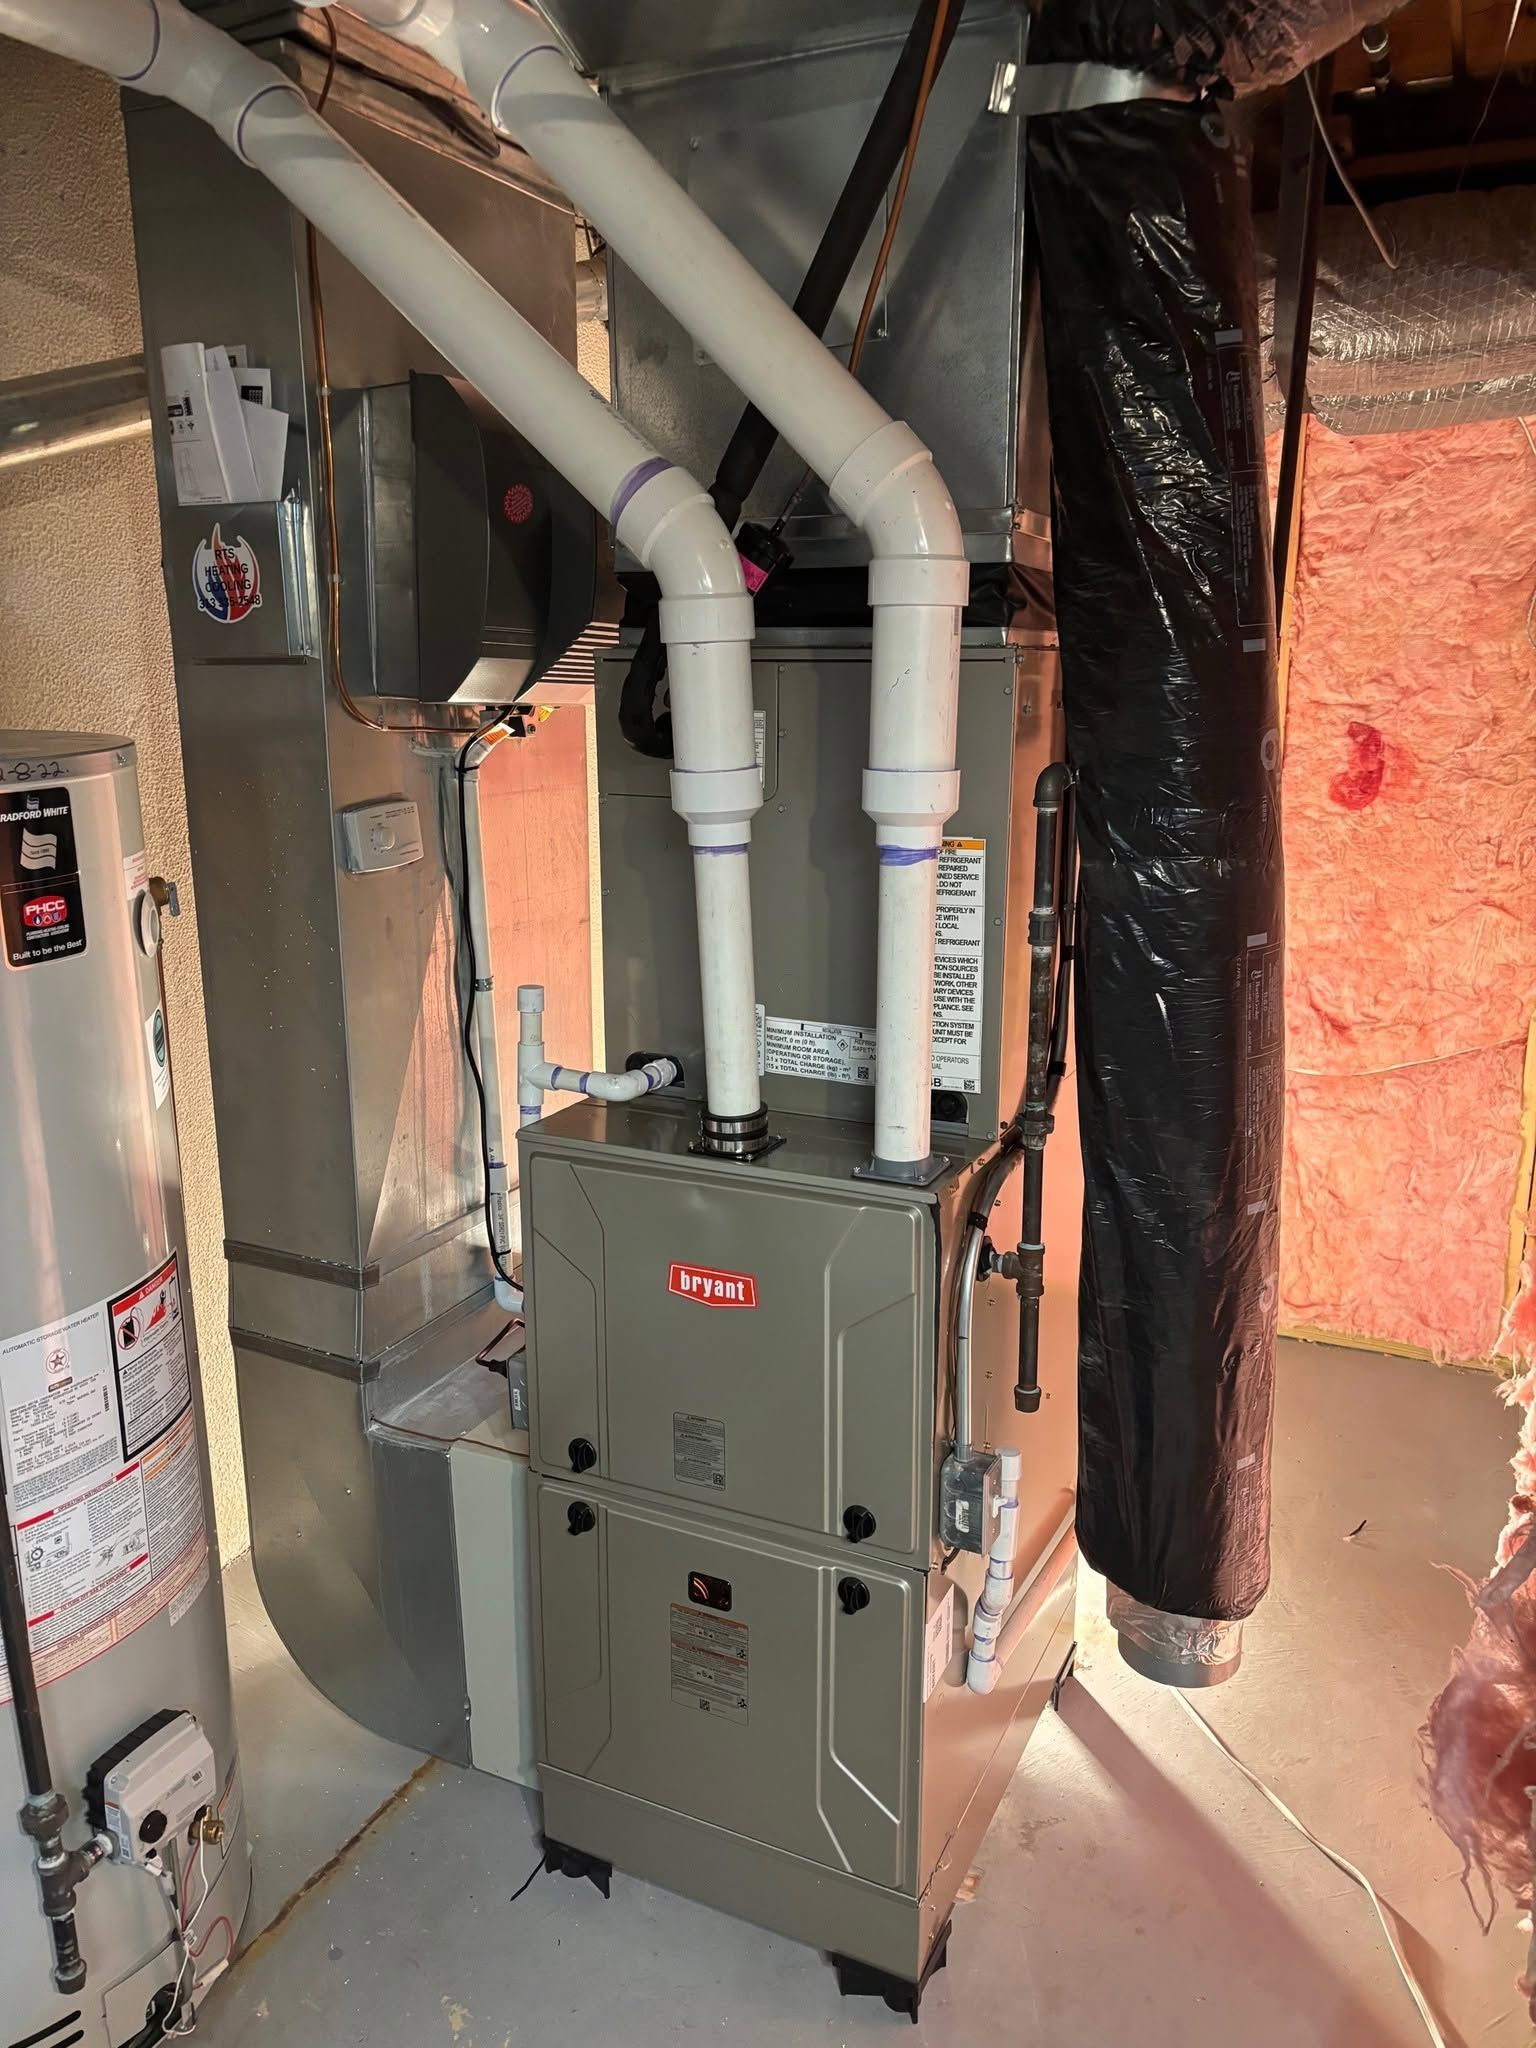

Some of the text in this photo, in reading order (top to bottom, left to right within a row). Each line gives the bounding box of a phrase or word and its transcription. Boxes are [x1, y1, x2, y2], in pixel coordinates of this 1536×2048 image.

[215, 548, 235, 560] RTS
[204, 563, 248, 577] HEATING
[205, 579, 251, 593] COOLING
[0, 806, 69, 822] RADFORD WHITE
[25, 900, 65, 915] PHCC
[936, 906, 969, 914] PROPERLY
[938, 938, 980, 946] REFRIGERANT
[12, 940, 82, 960] Built to be the Best
[942, 972, 975, 980] INSTALLED
[947, 988, 974, 996] DEVICES
[963, 996, 976, 1004] THE
[961, 1004, 974, 1012] SEE
[949, 1021, 974, 1029] SYSTEM
[767, 1027, 837, 1041] MINIMUM INSTALLATION
[767, 1041, 792, 1050] MINIMUM
[792, 1044, 812, 1053] ROOM
[852, 1046, 874, 1054] SAFETY
[766, 1048, 801, 1059] (OPERATING
[936, 1055, 970, 1064] OPERATORS
[779, 1057, 798, 1066] TOTAL
[799, 1060, 825, 1070] CHARGE
[766, 1062, 775, 1070] (15
[779, 1064, 798, 1073] TOTAL
[799, 1067, 826, 1077] CHARGE
[826, 1071, 837, 1079] (lb)
[680, 1270, 744, 1301] bryant
[2, 1311, 100, 1355] AUTOMATIC STORAGE WATER HEATER
